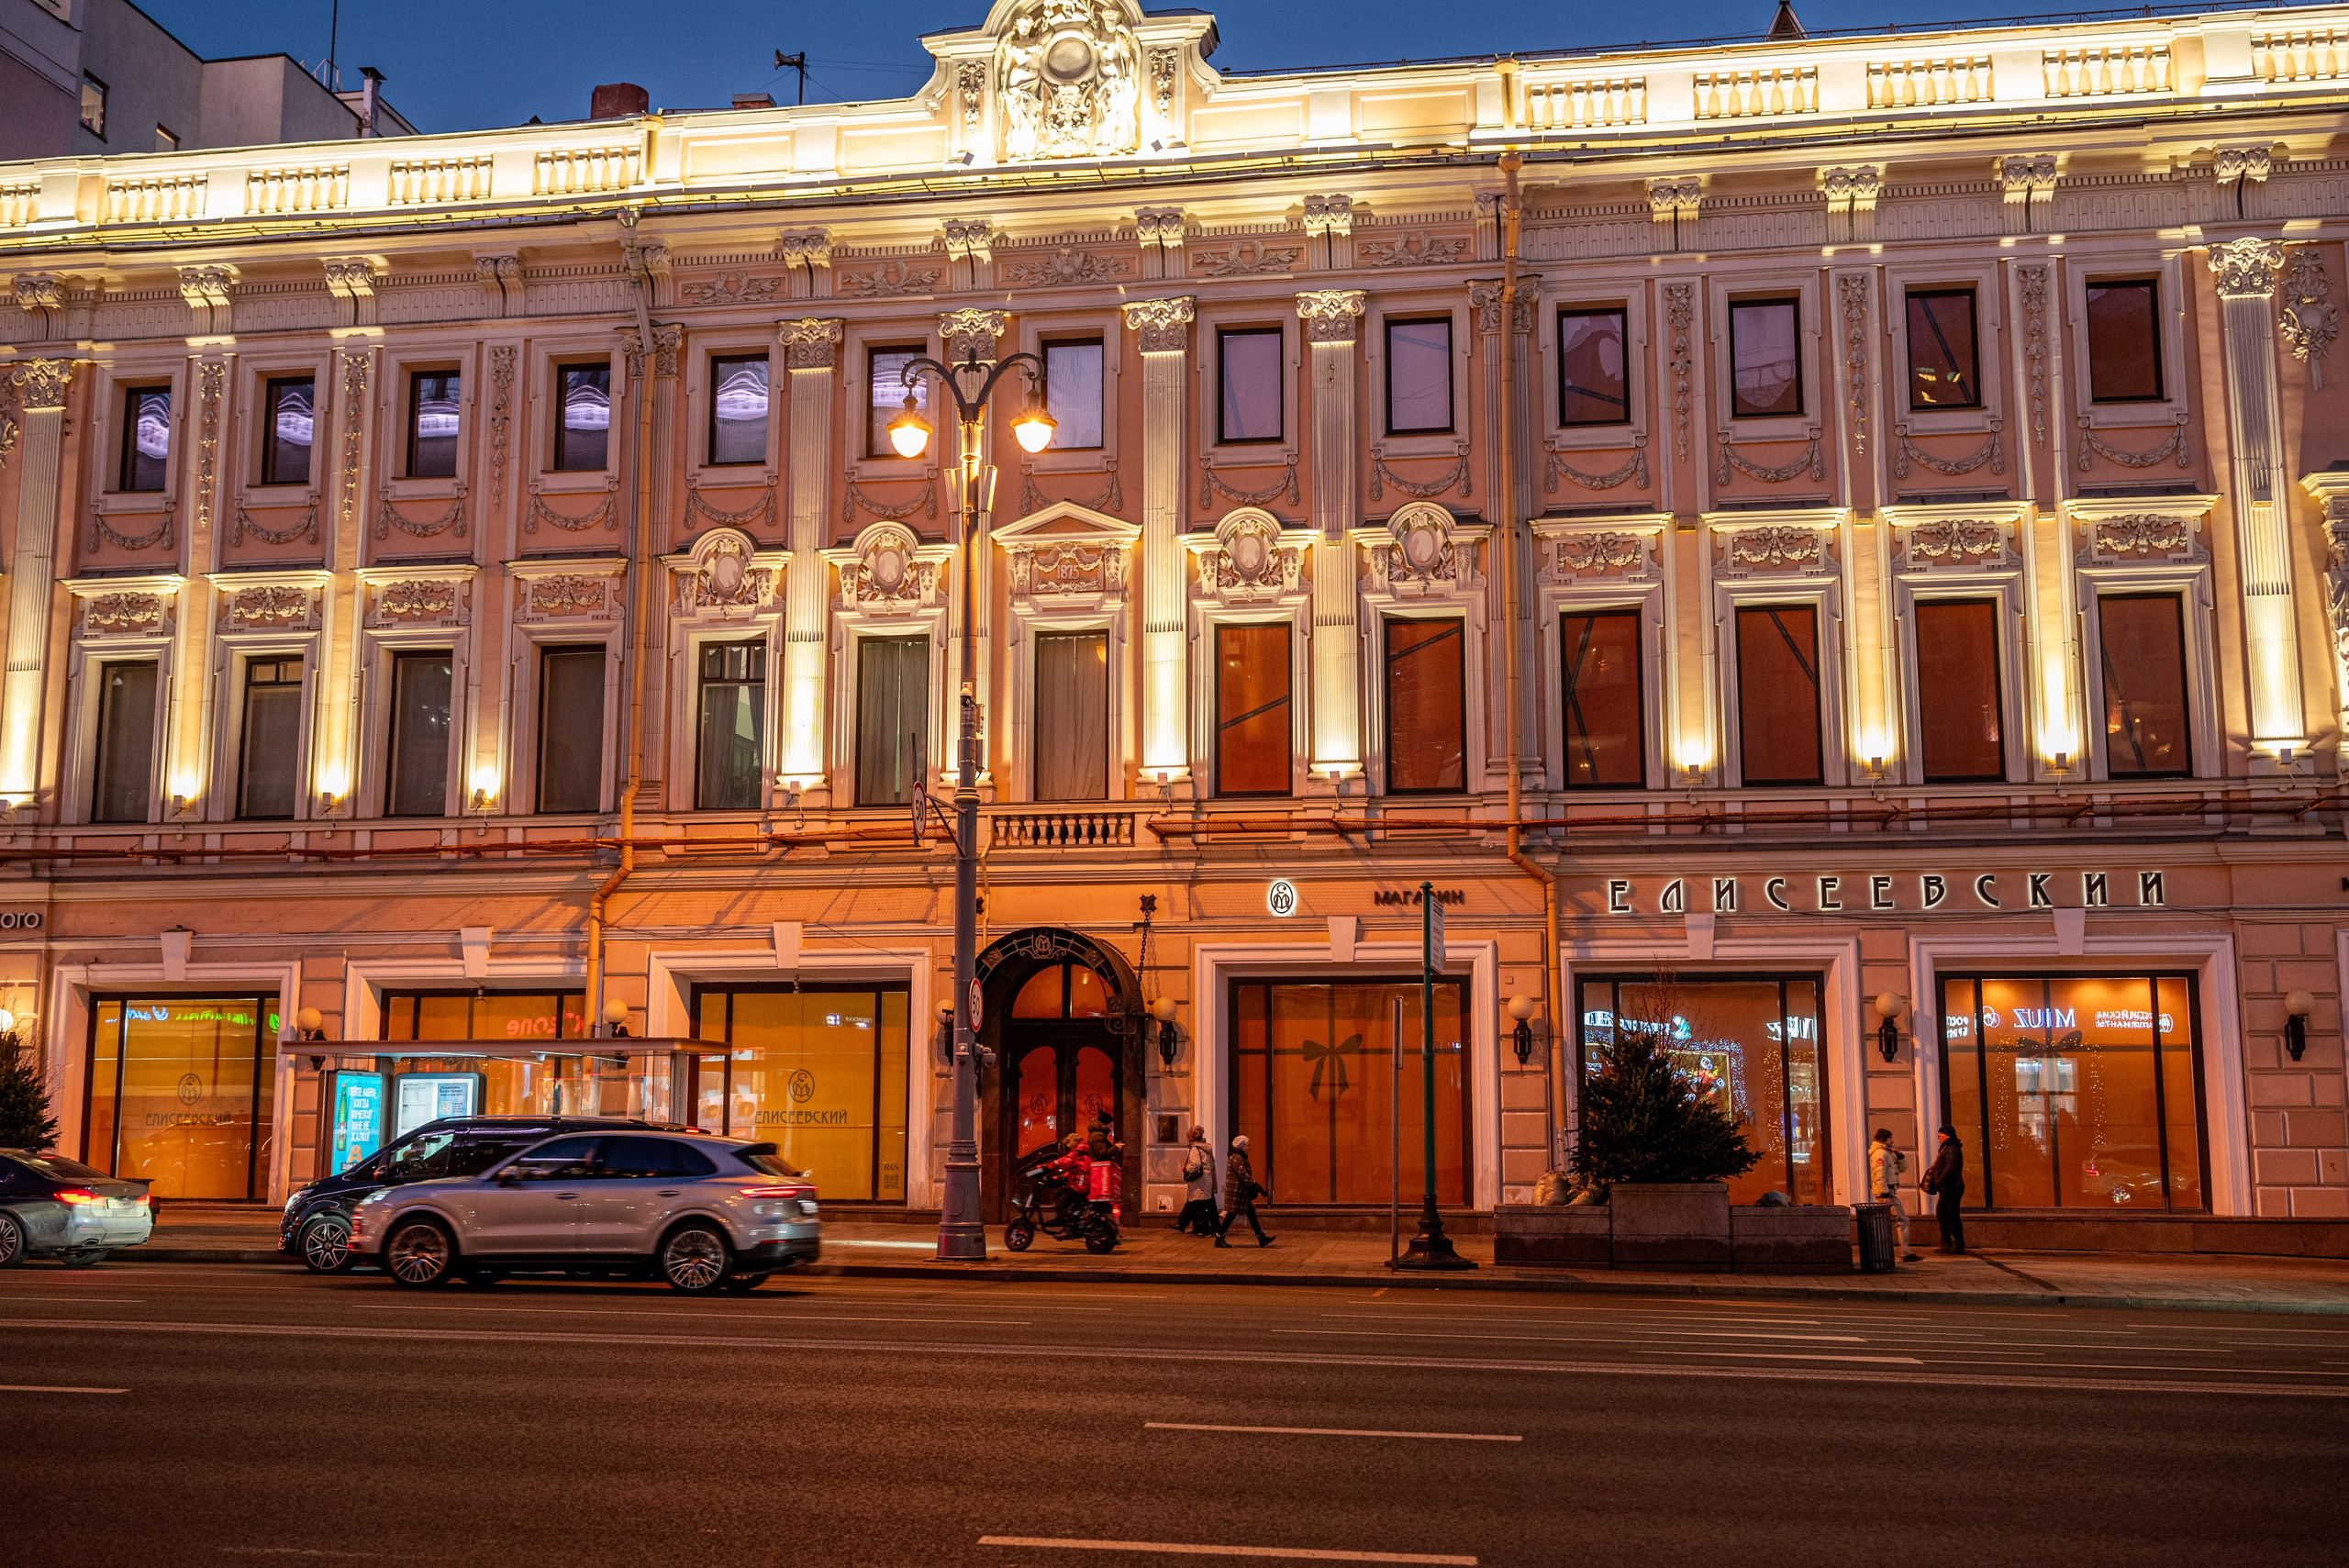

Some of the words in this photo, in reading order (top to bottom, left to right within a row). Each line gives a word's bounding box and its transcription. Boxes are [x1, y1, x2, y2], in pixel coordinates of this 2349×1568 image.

[1057, 564, 1080, 579] 1875
[915, 799, 924, 822] 50
[1375, 890, 1464, 906] МАГАИН
[1608, 871, 2165, 913] ЕЛИСЕЕВСКИЙ
[973, 994, 981, 1016] 50
[353, 1098, 370, 1108] КОГДА
[145, 1111, 231, 1126] ЕЛИСЕЕВСКИЙ
[754, 1108, 847, 1124] ЕЛИСЕЕВСКИЙ
[351, 1121, 362, 1131] МНЕ
[362, 1121, 370, 1130] НЕ
